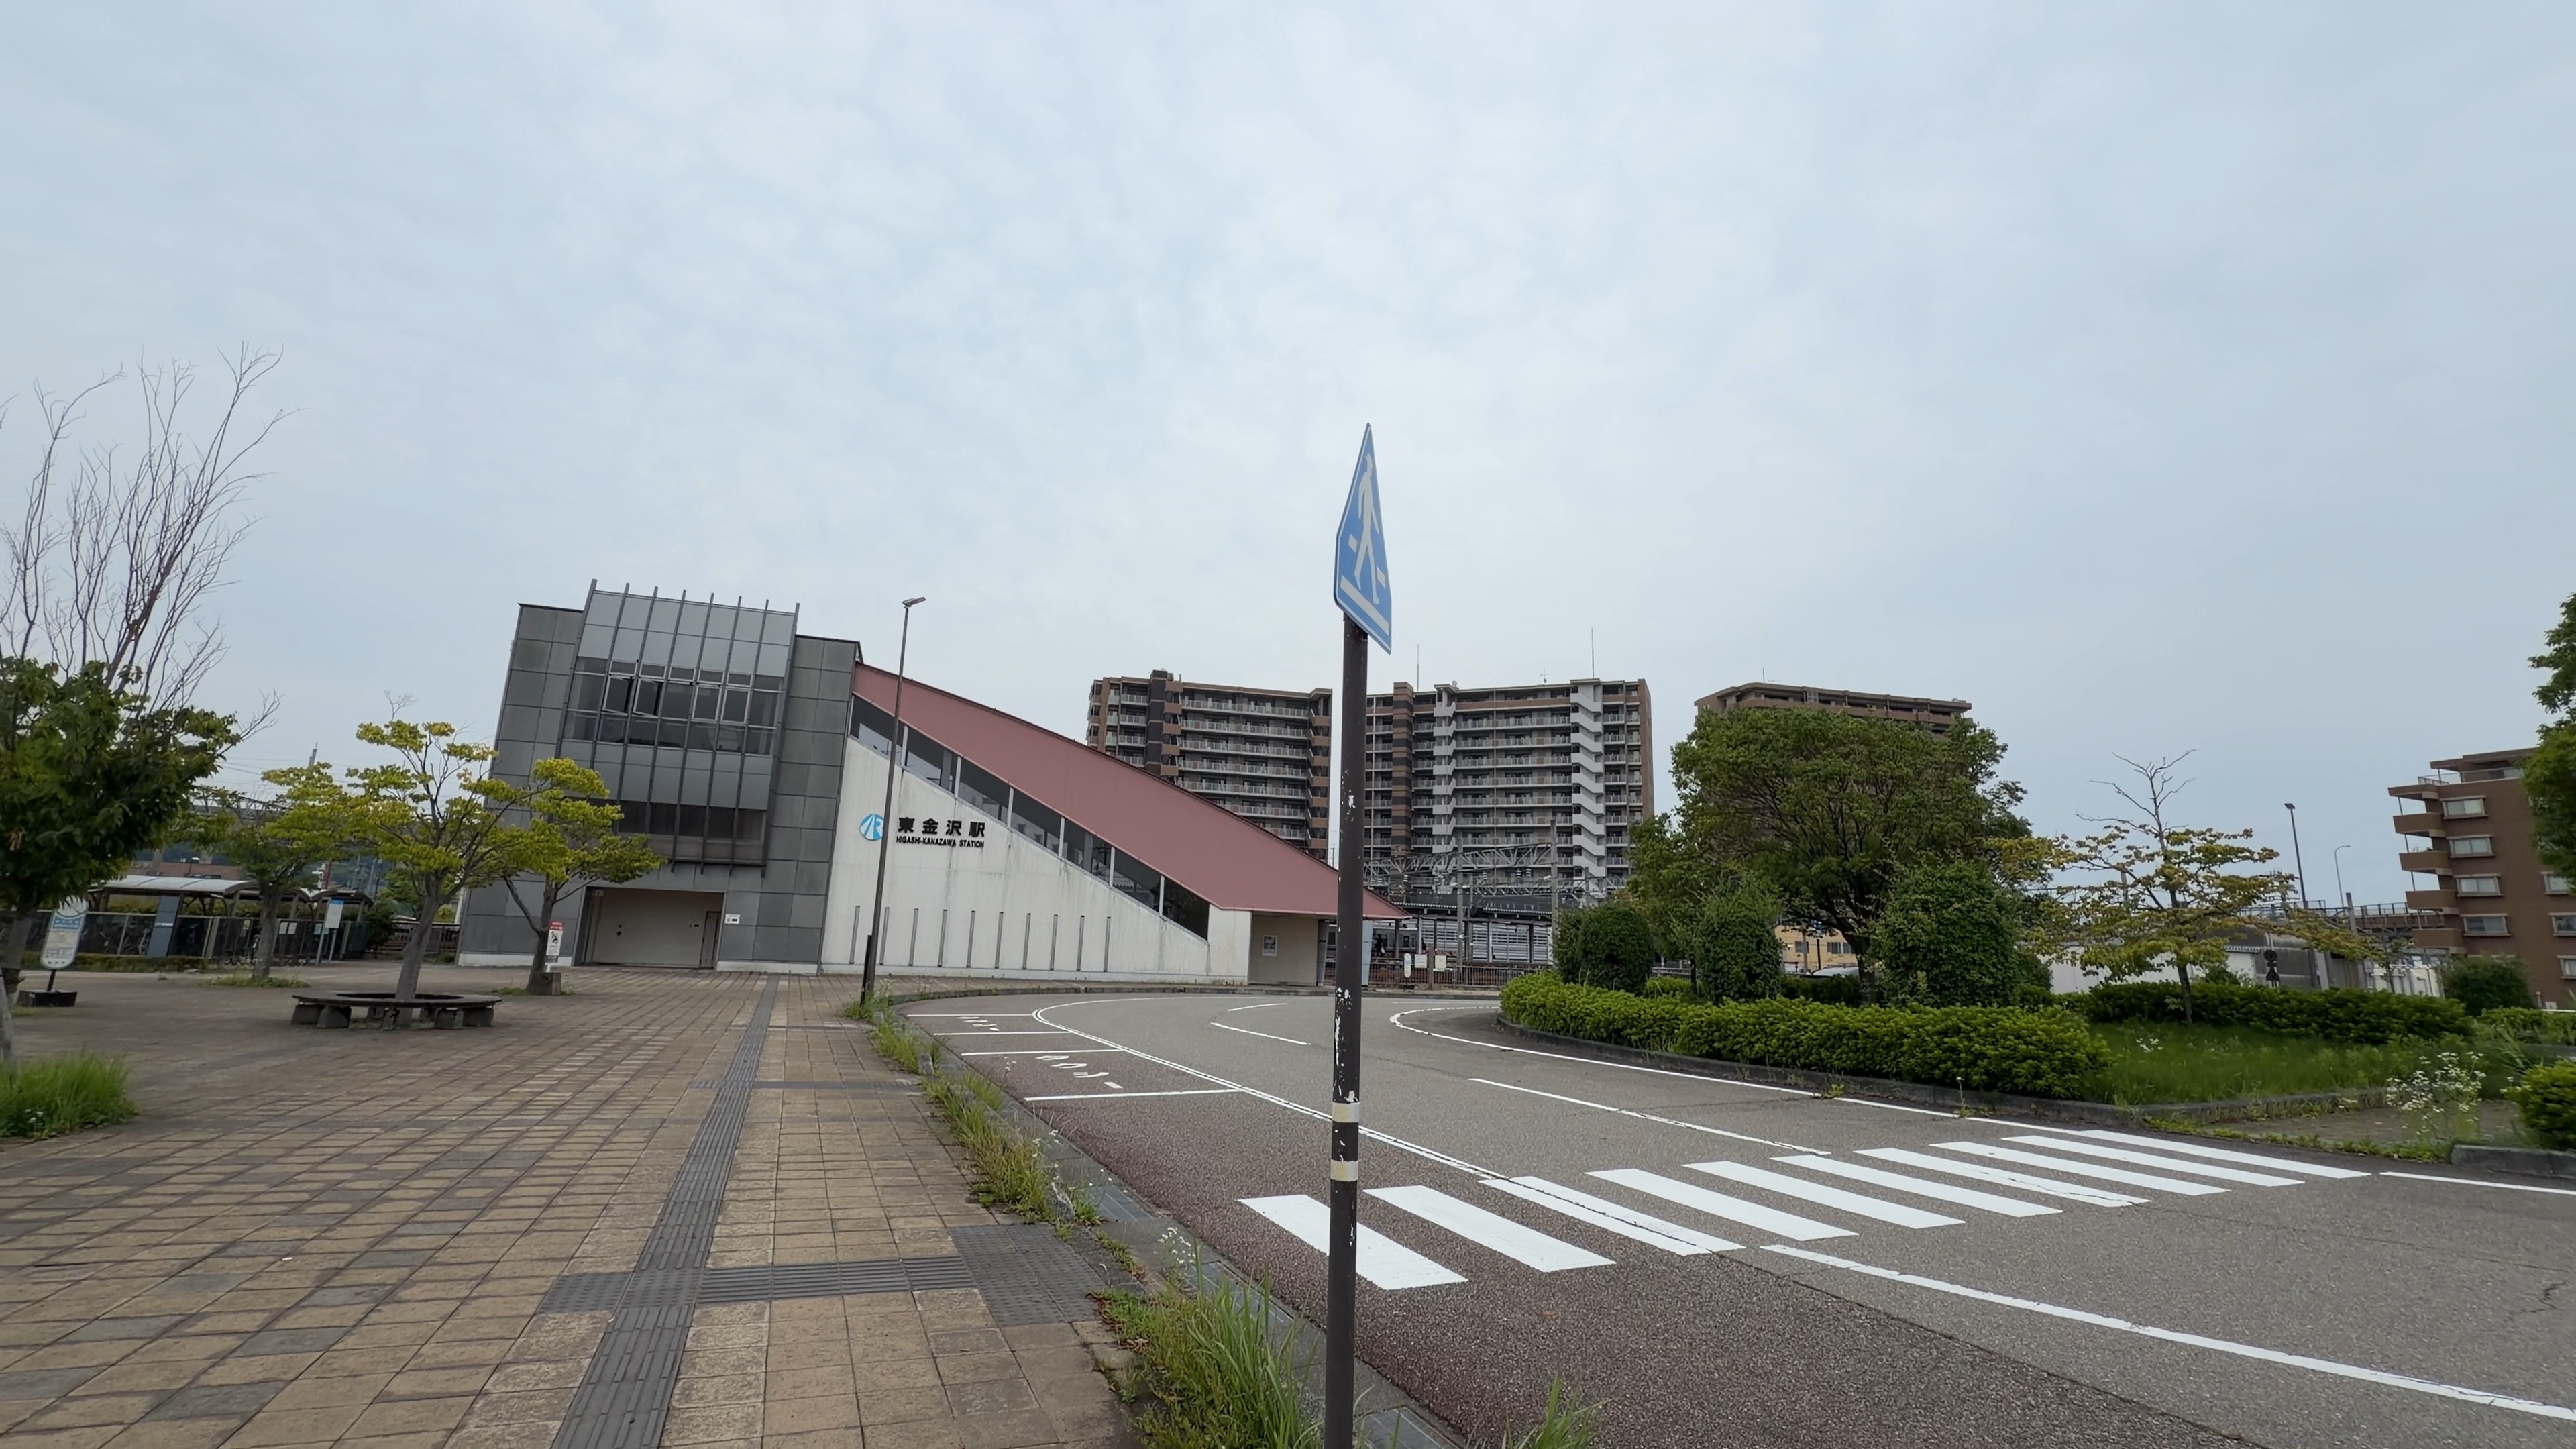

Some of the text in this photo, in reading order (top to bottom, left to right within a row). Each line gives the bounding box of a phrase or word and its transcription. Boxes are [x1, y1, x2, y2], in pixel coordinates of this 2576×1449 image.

[898, 817, 985, 837] 東金沢駅
[896, 837, 985, 848] HIGASHI-KANAZAWA STATION
